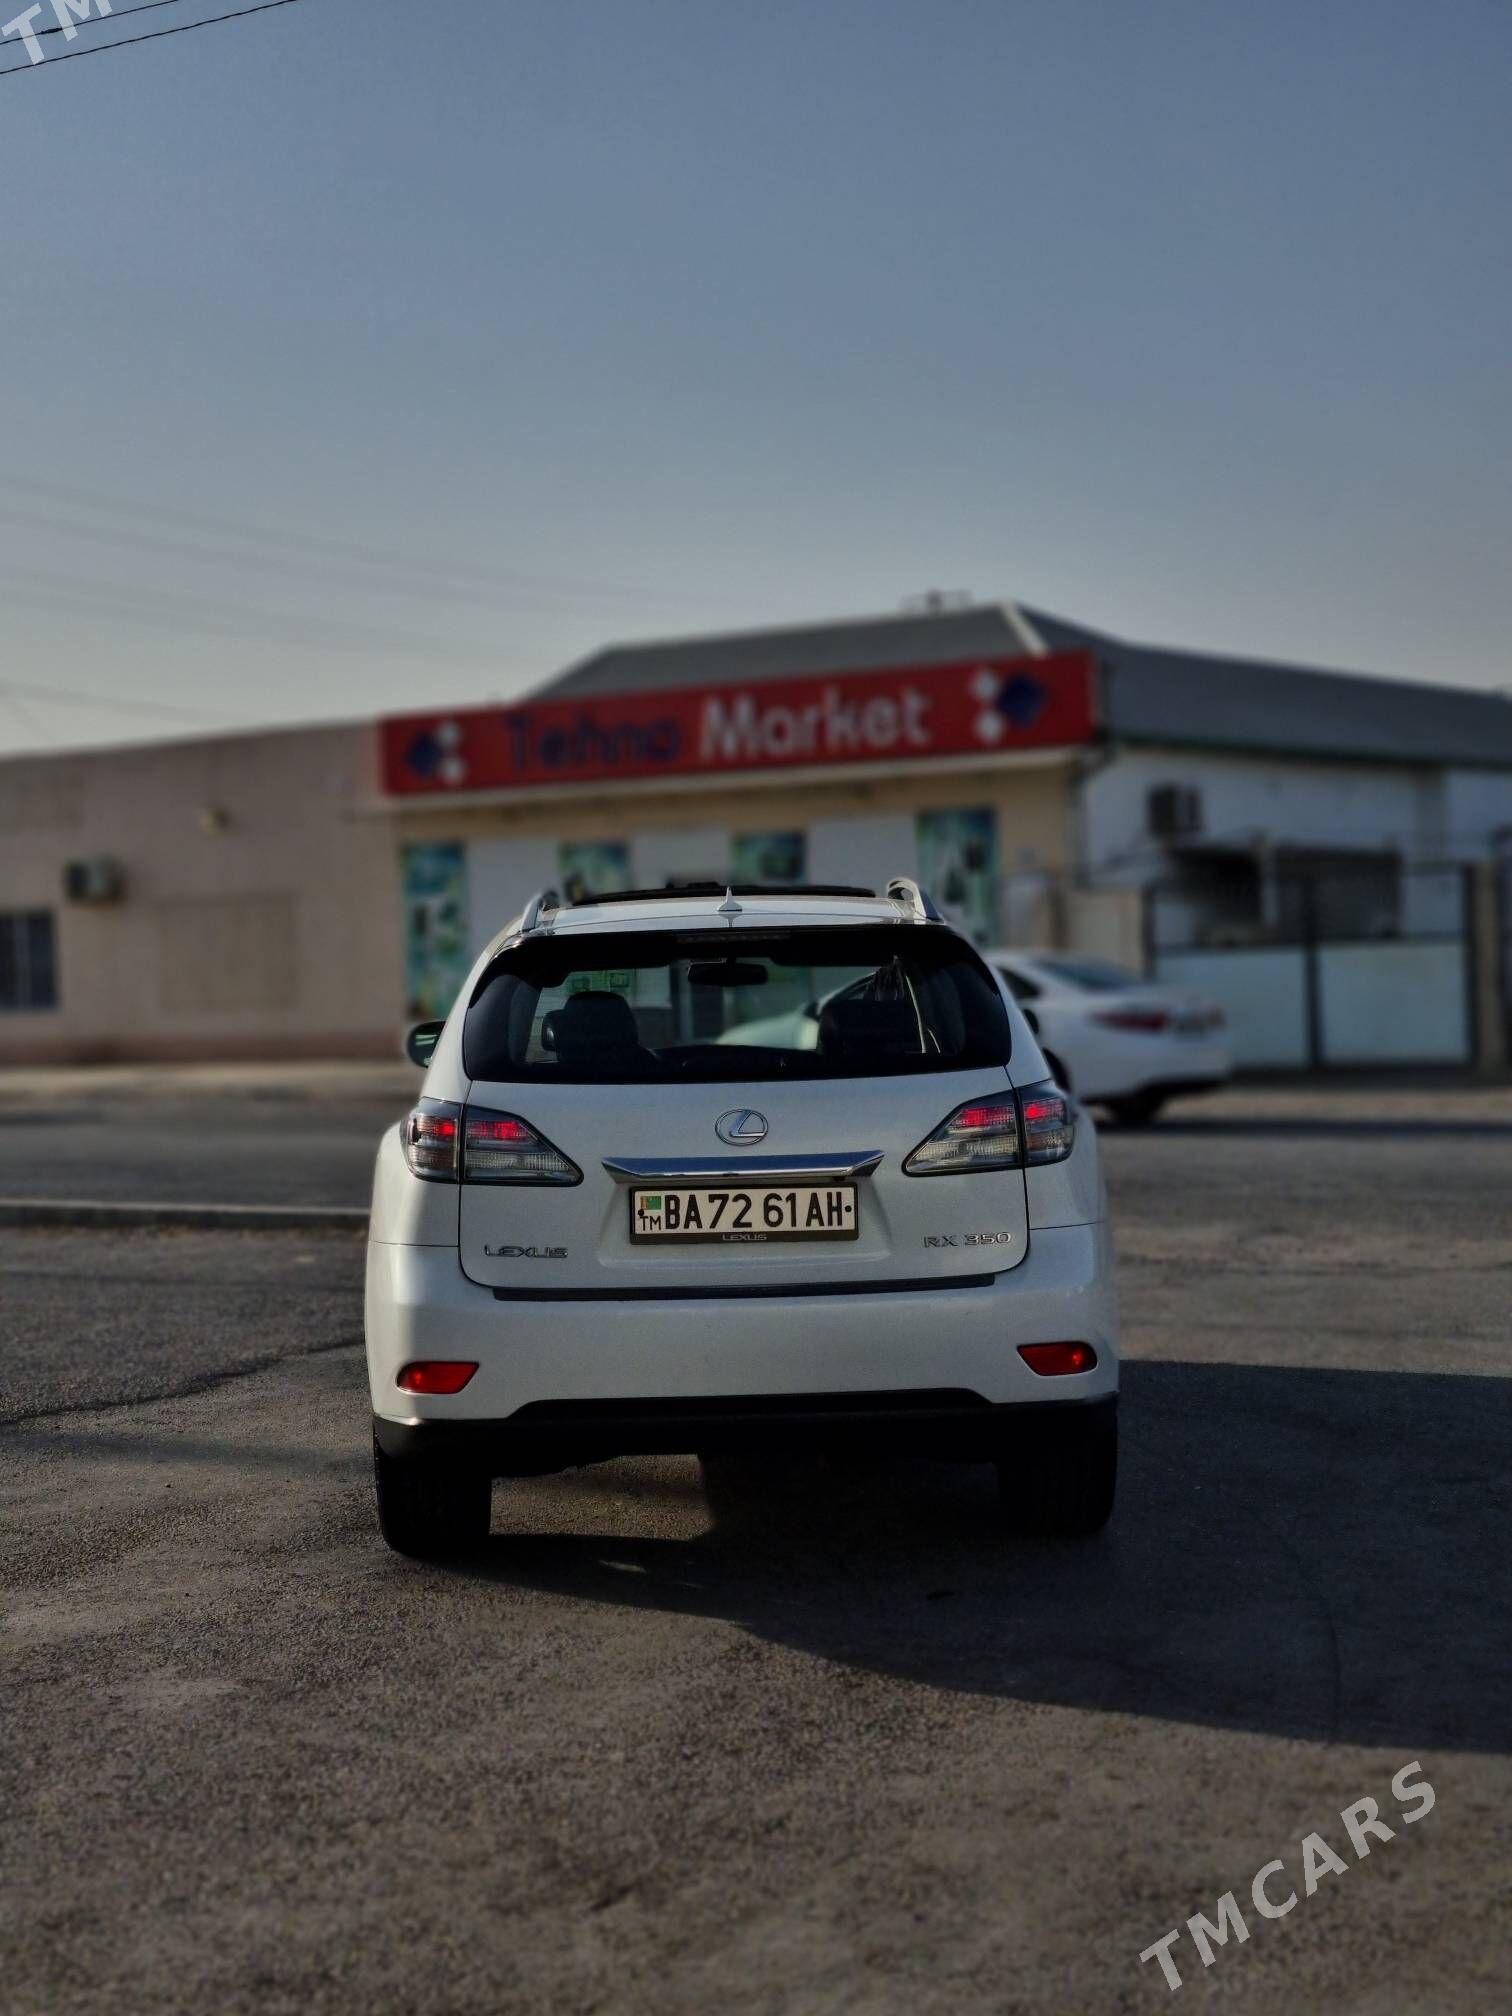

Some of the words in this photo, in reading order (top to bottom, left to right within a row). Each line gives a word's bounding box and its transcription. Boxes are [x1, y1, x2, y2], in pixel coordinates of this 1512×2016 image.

[504, 713, 681, 770] Tehno
[701, 687, 932, 759] Market
[640, 1215, 662, 1231] TM
[722, 1233, 768, 1241] LEXUS
[923, 1235, 958, 1248] RX
[964, 1231, 1011, 1246] 350
[484, 1244, 568, 1259] LEXUS
